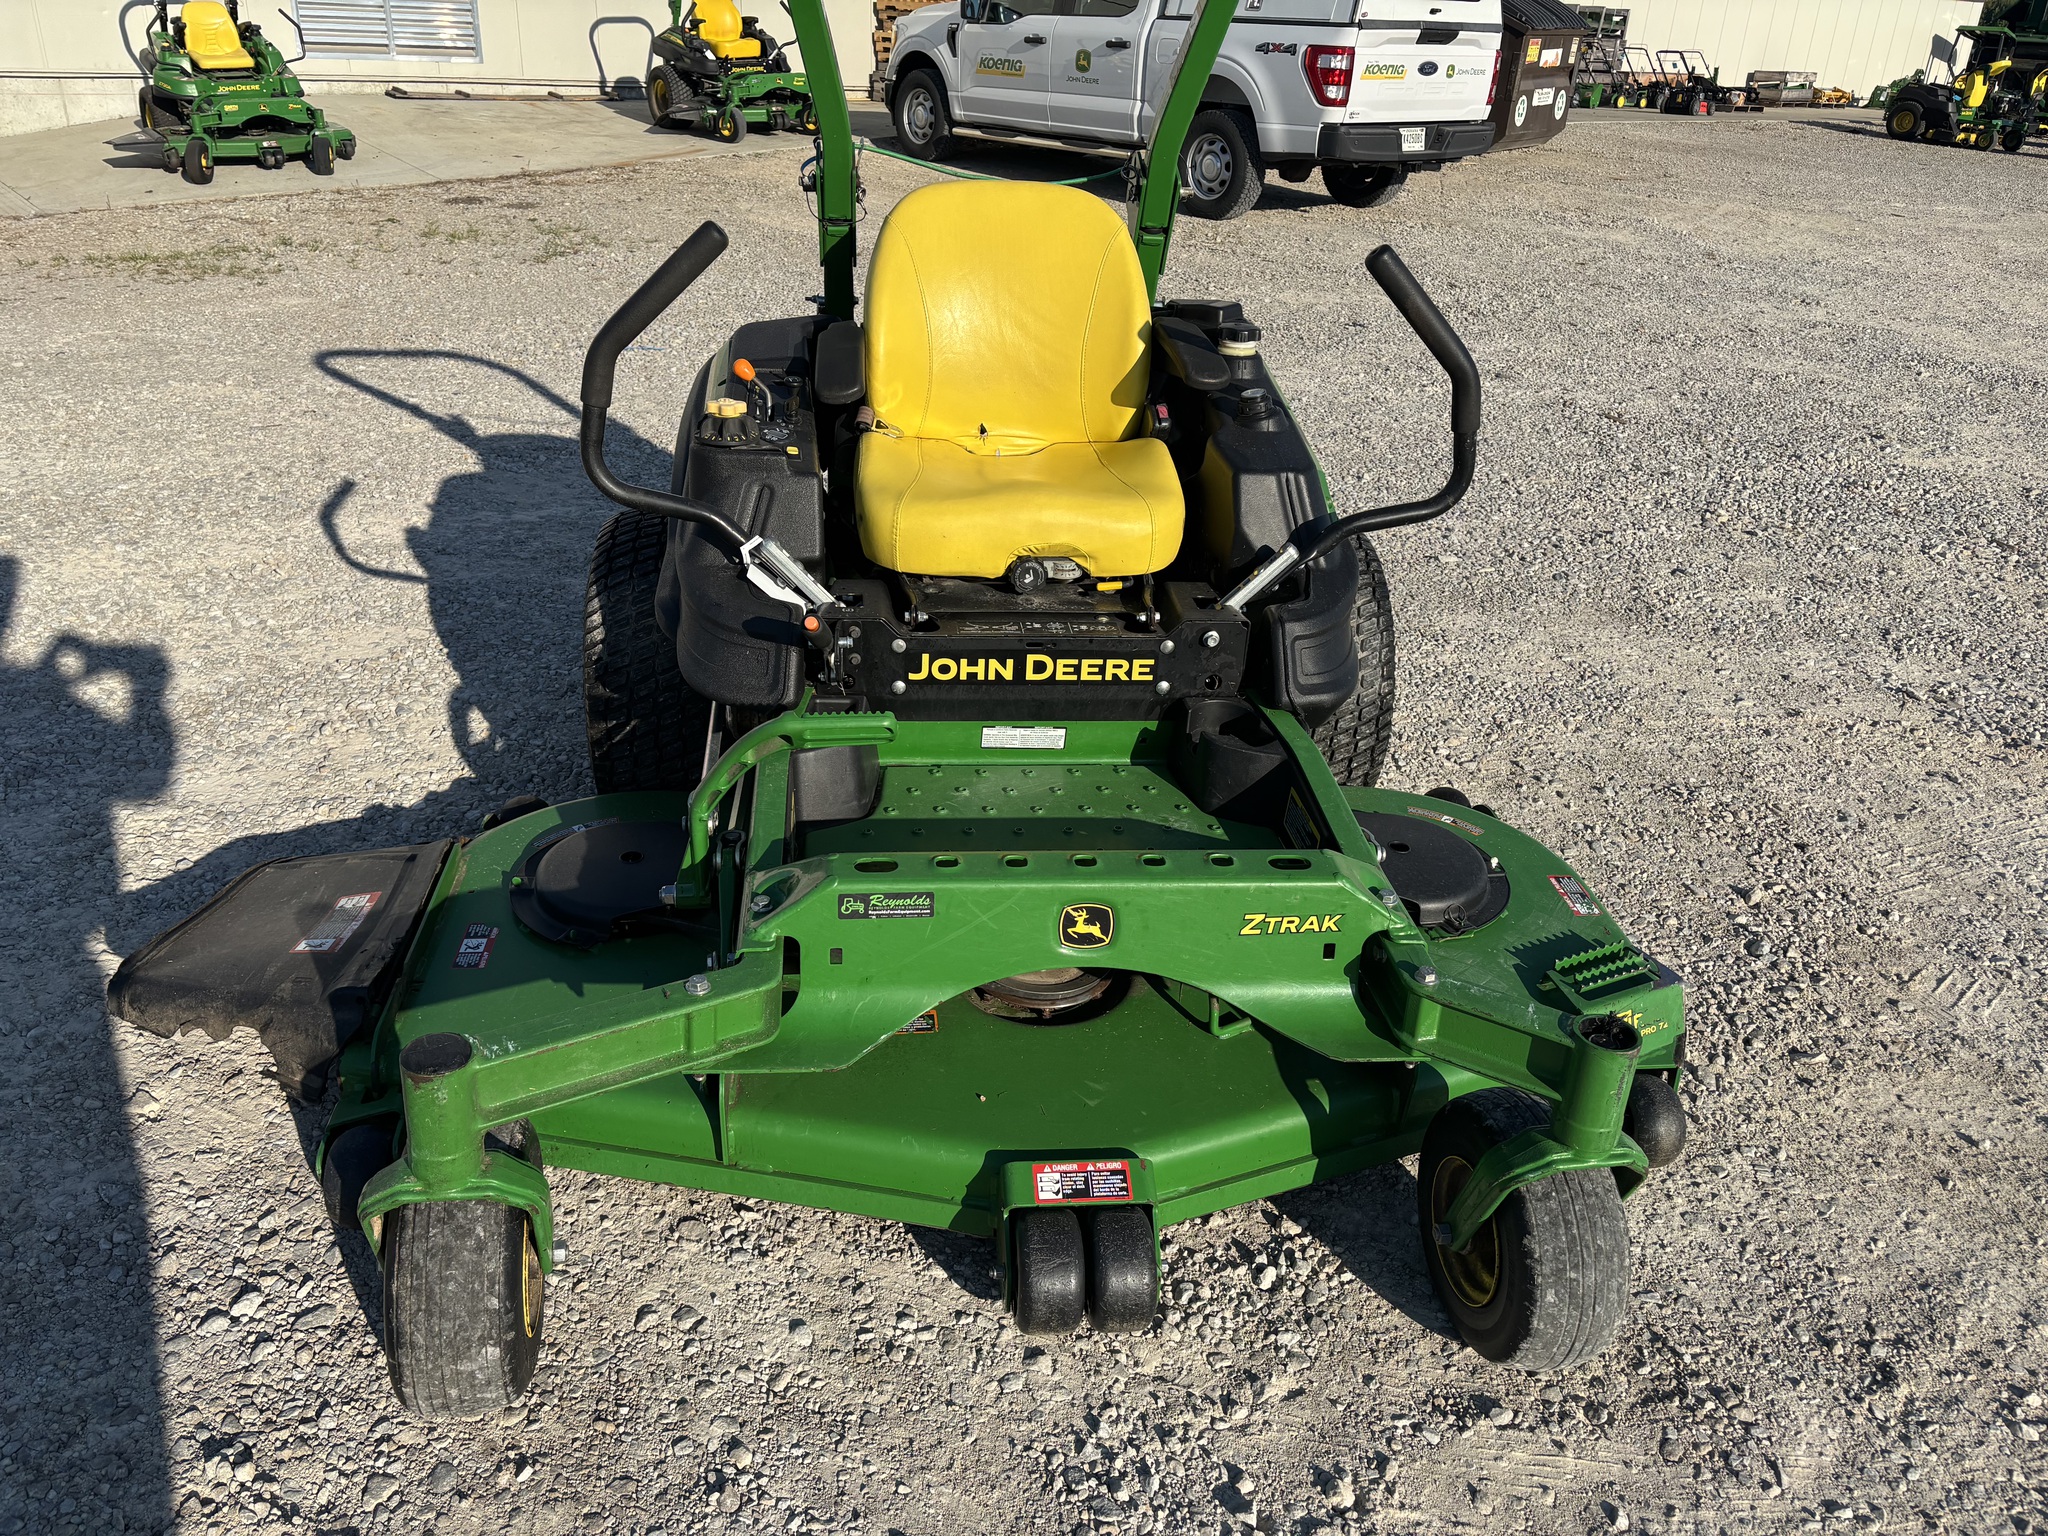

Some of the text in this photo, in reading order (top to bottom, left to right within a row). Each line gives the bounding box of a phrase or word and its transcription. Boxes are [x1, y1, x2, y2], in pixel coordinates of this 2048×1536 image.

[1456, 67, 1487, 76] JOHN DEERE
[1066, 75, 1100, 85] JOHN DEERE
[908, 653, 1155, 681] JOHN DEERE
[870, 894, 931, 909] Reynolds
[1239, 913, 1344, 935] ZTRAK
[1640, 1025, 1657, 1037] PRO
[1096, 1162, 1122, 1170] PELIGRO
